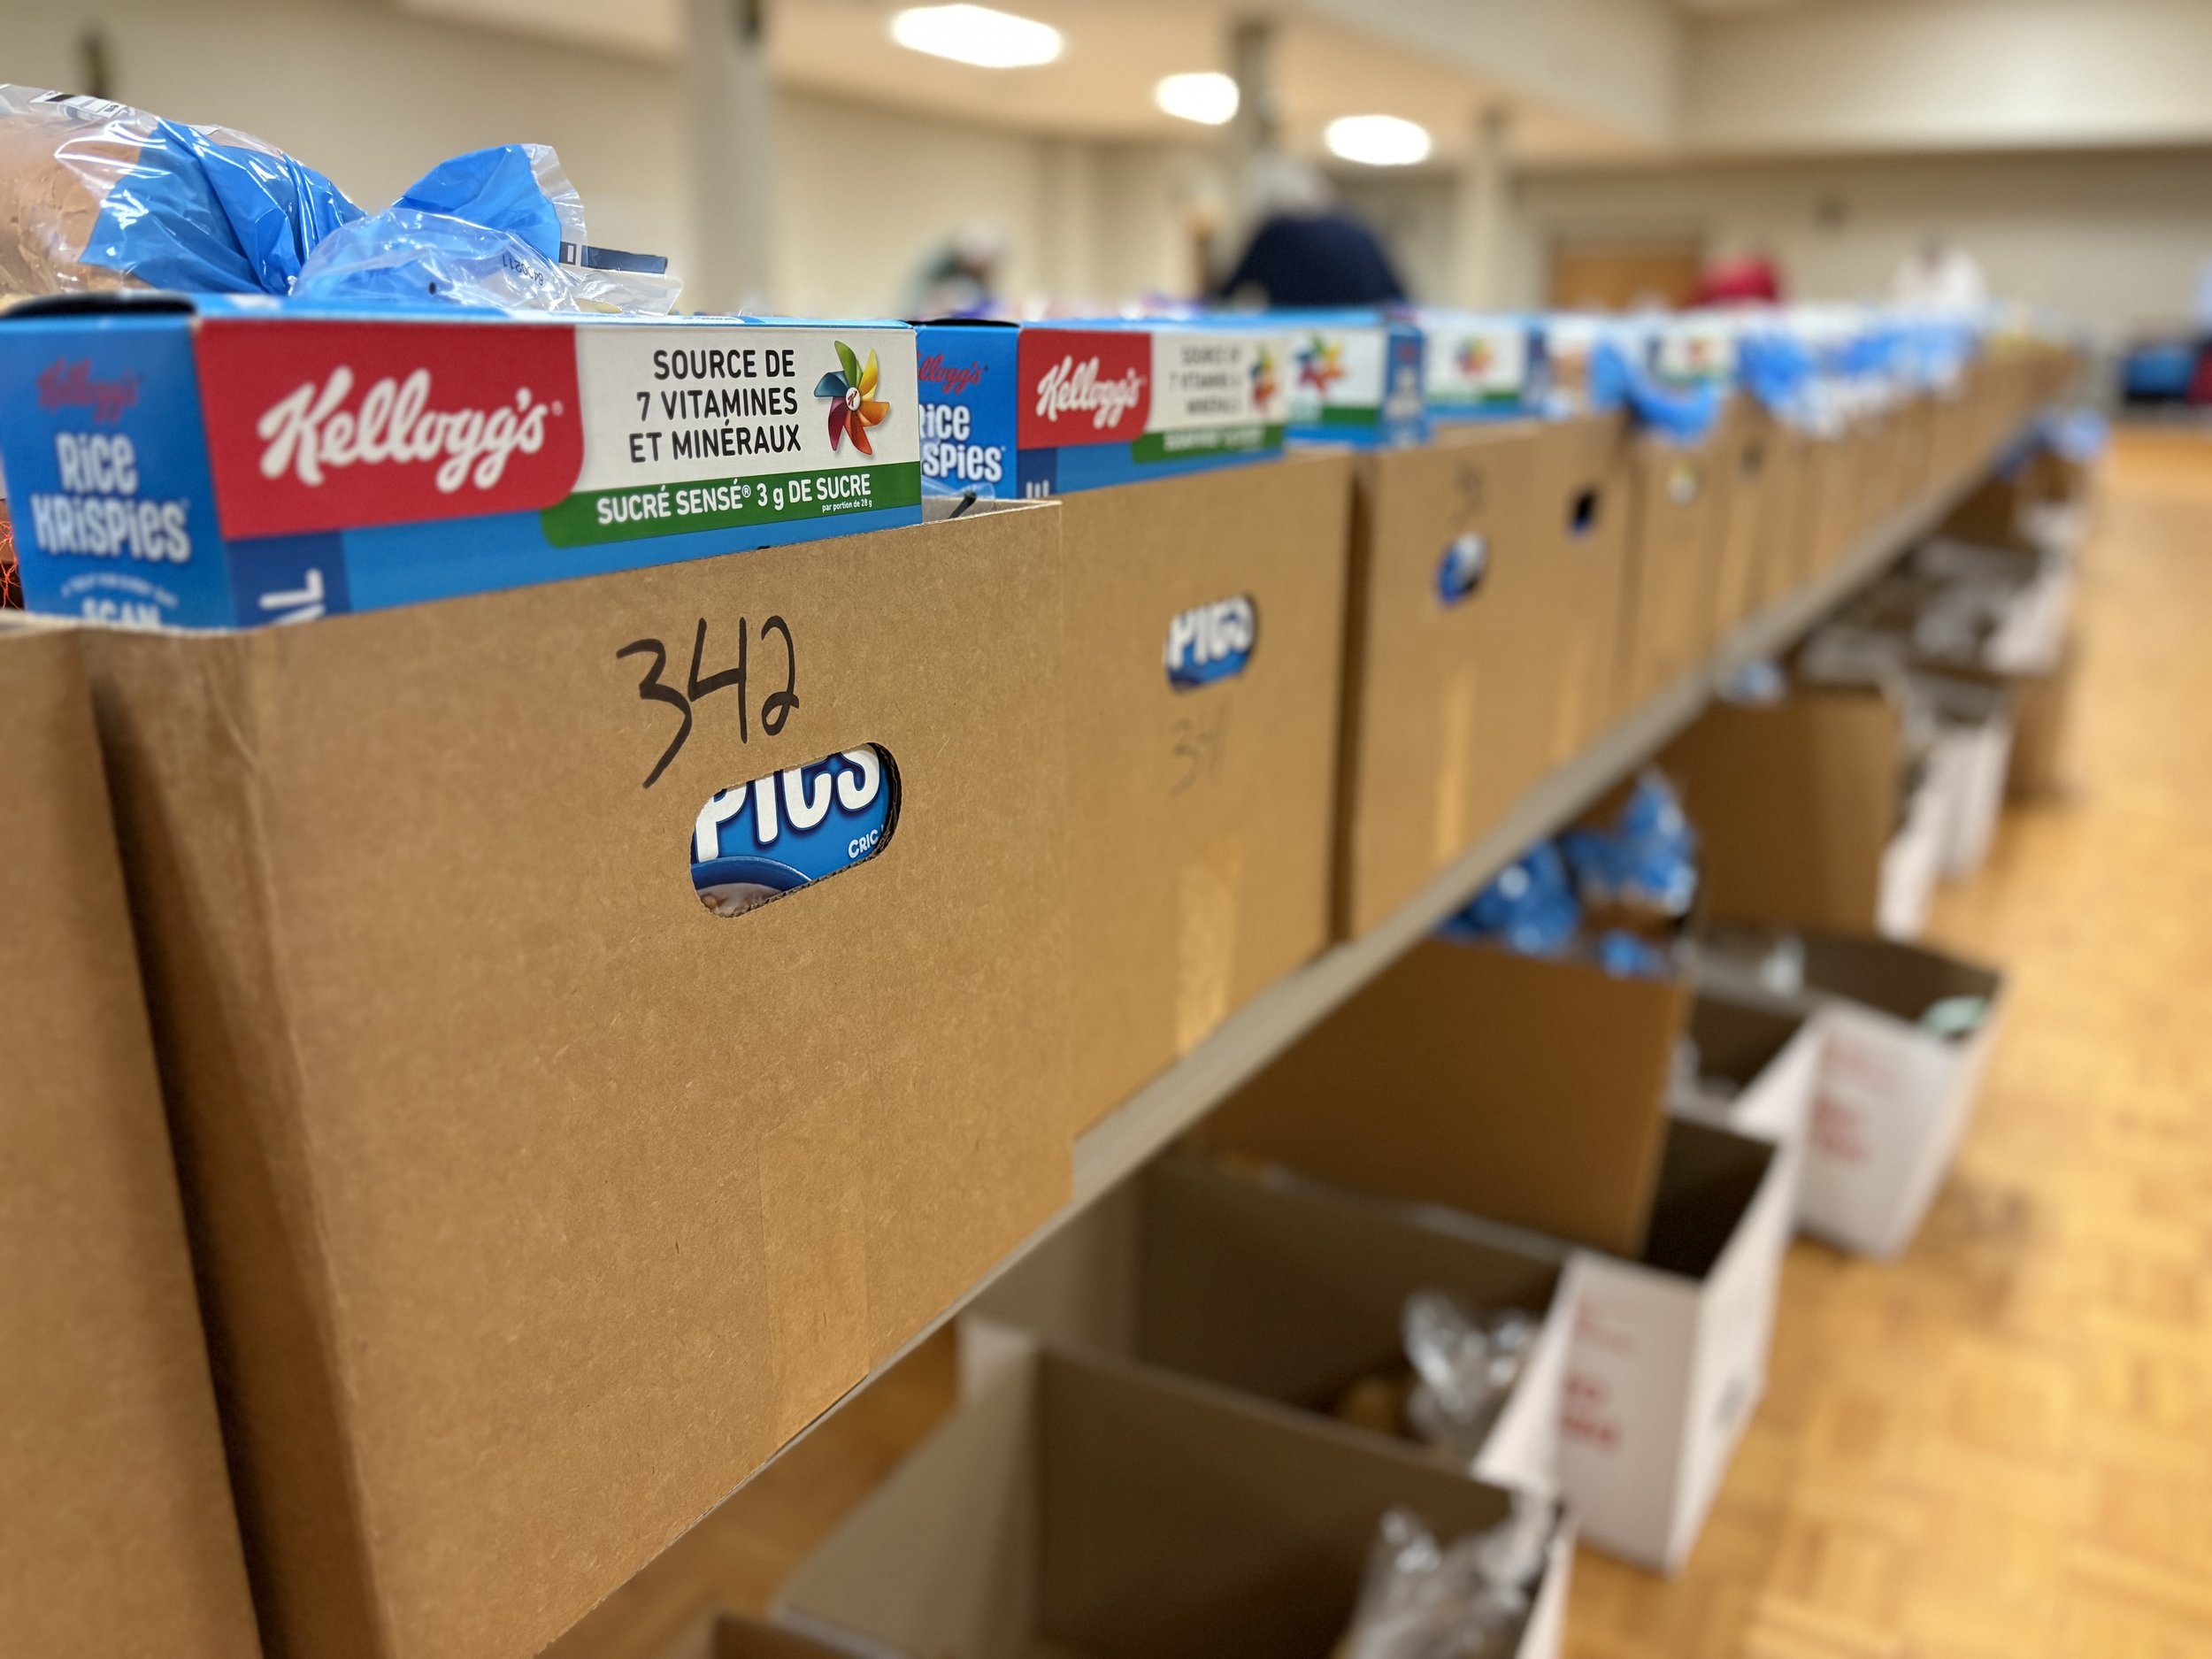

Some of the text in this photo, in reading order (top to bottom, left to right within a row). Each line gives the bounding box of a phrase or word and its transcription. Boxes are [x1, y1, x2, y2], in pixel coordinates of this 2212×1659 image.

[653, 349, 795, 380] SOURCE DE
[918, 352, 982, 395] llogg's
[636, 387, 798, 422] 7 VITAMINES
[1036, 356, 1140, 429] Kellogg's
[257, 365, 549, 494] Kellogg's
[629, 419, 801, 463] ET MINÉRAUX
[596, 485, 672, 525] SUCRÉ
[757, 483, 769, 507] 3
[772, 488, 785, 511] g
[788, 480, 812, 503] DE
[817, 473, 872, 501] SUCRE
[822, 504, 832, 513] par
[833, 501, 853, 512] portion
[853, 499, 861, 508] de
[617, 615, 800, 788] 342
